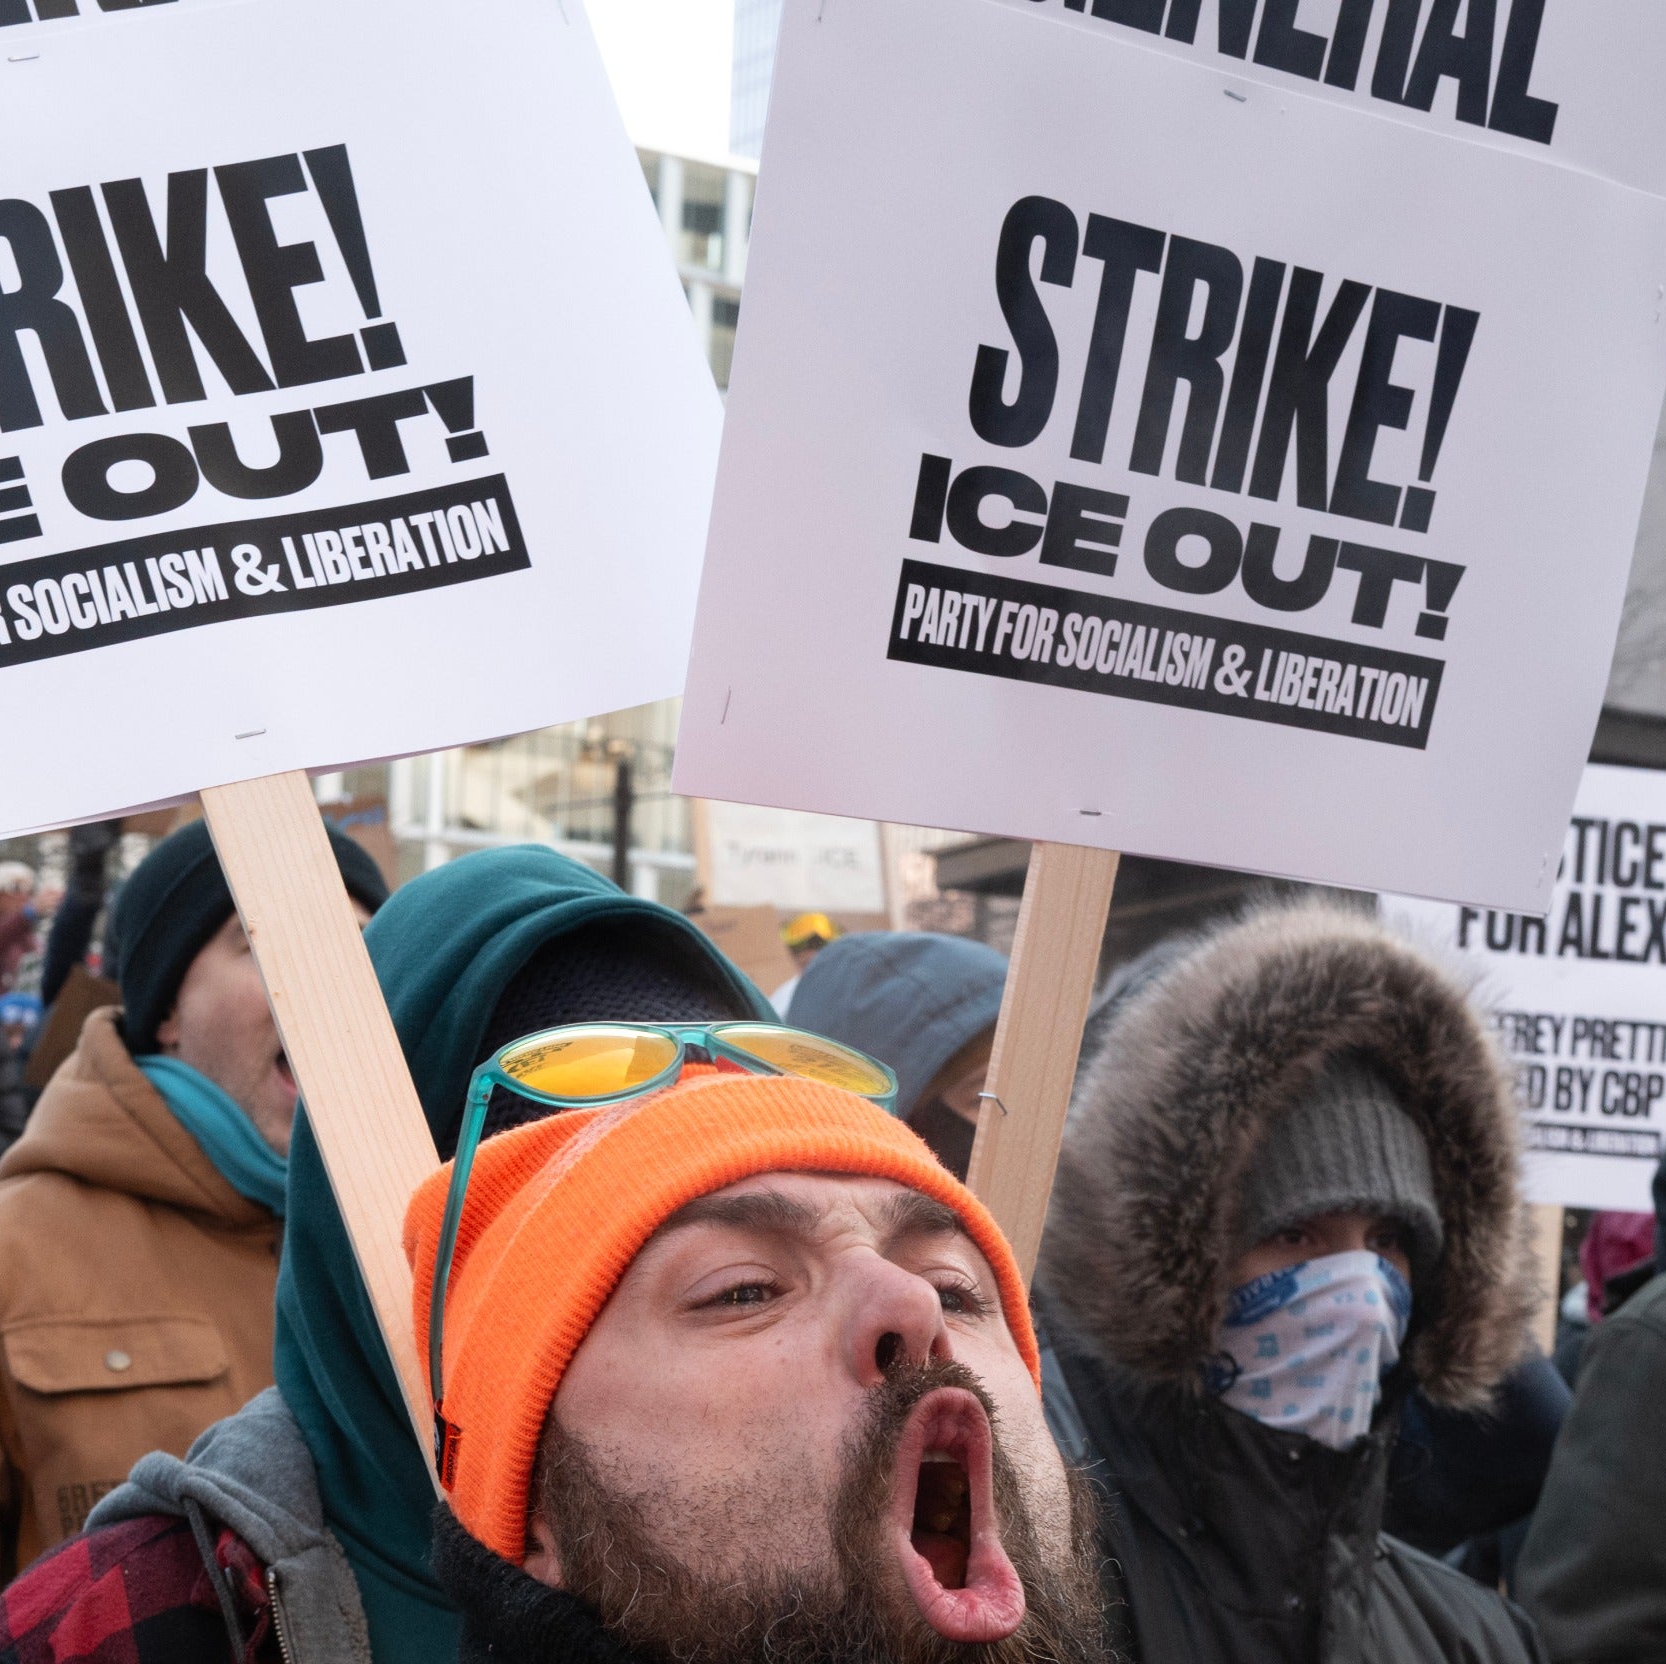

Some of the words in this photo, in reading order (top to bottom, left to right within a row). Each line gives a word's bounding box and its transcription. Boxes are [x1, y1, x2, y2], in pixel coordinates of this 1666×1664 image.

[969, 196, 1480, 533] STRIKE!
[62, 376, 490, 521] OUT!
[7, 547, 230, 641] SOCIALISM
[230, 543, 290, 596] &
[281, 498, 511, 589] LIBERATION
[909, 453, 1130, 577] ICE
[1144, 507, 1467, 641] OUT!
[900, 584, 998, 654] PARTY
[993, 601, 1060, 664] FOR
[1056, 613, 1216, 691] SOCIALISM
[1214, 644, 1252, 698] &
[1254, 649, 1430, 729] LIBERATION
[1554, 1066, 1596, 1113] BY
[1601, 1070, 1666, 1119] CBP
